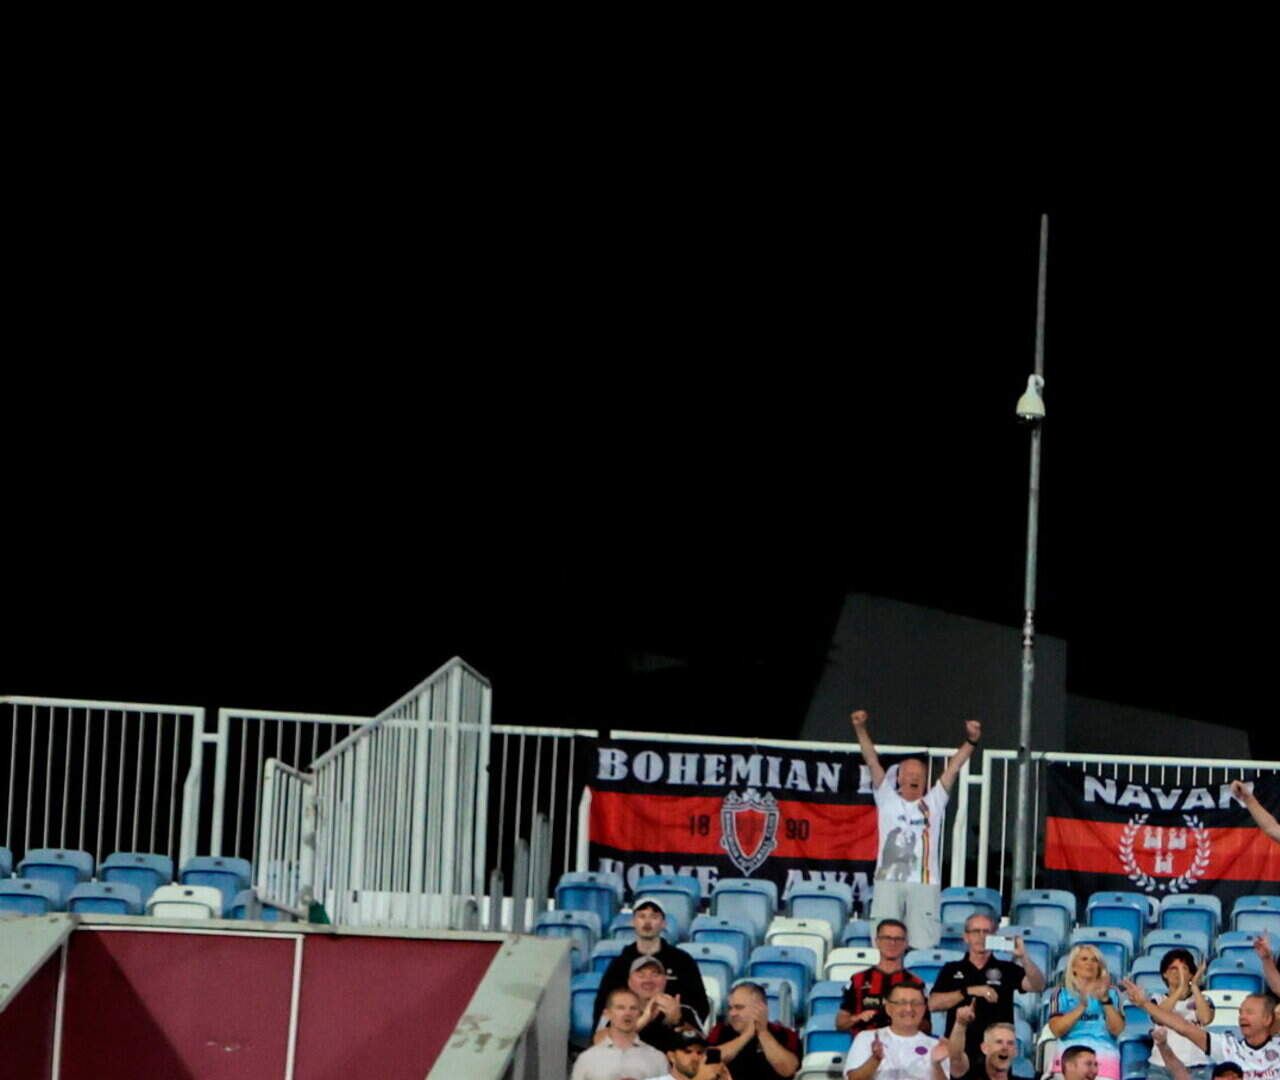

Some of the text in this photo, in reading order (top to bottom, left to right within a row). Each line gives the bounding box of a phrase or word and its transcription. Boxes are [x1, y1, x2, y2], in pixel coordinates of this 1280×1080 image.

[597, 748, 842, 794] BOHEMIAN
[1084, 774, 1255, 811] NAVAN
[689, 814, 711, 837] 18
[785, 818, 811, 842] 90
